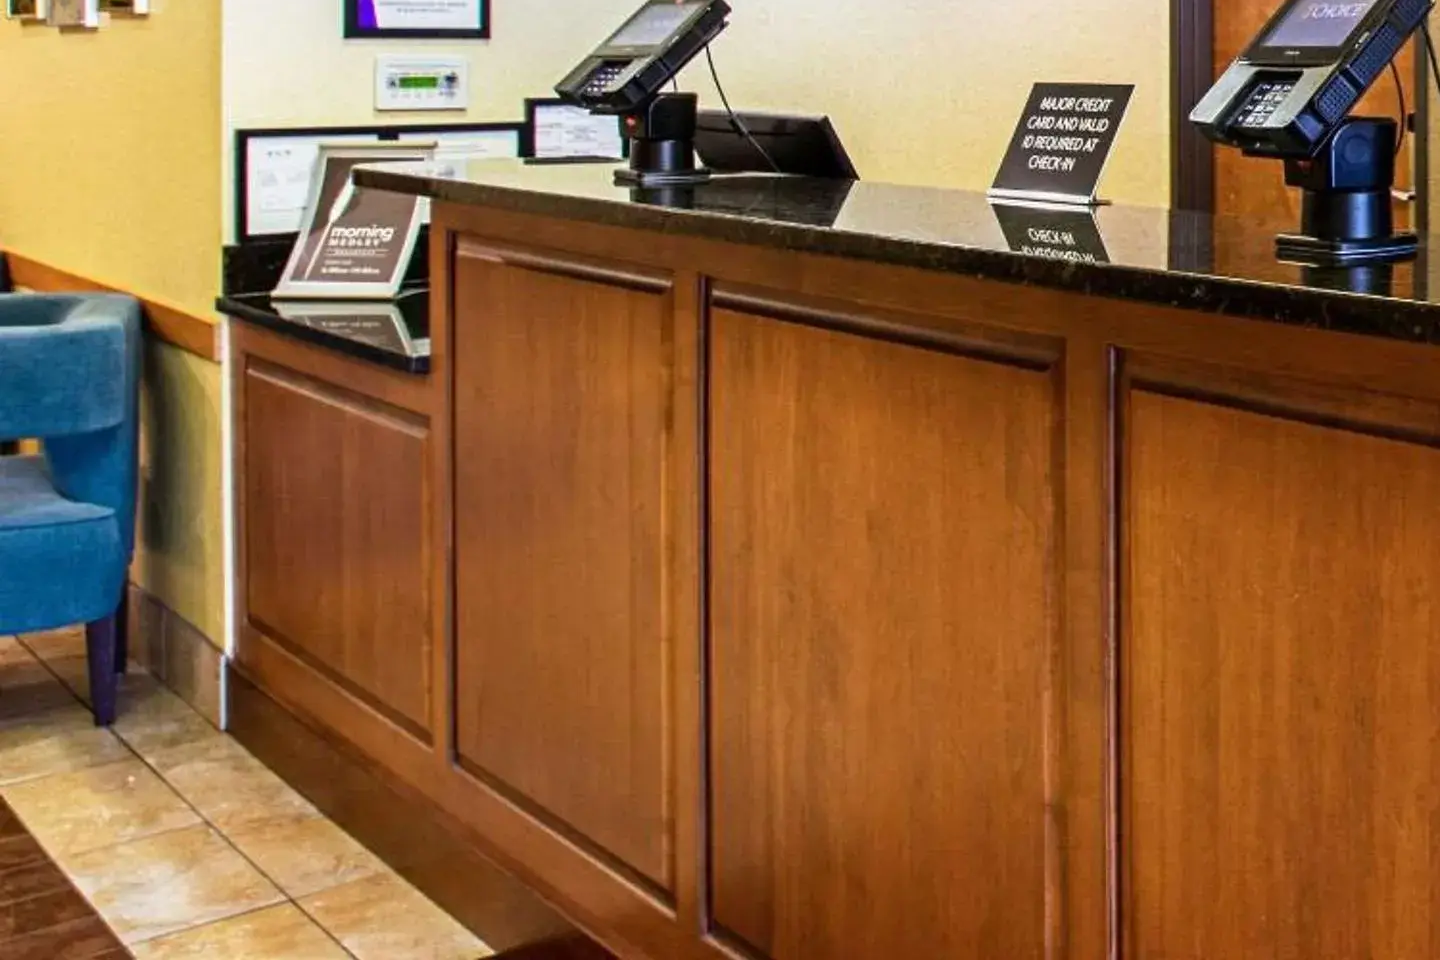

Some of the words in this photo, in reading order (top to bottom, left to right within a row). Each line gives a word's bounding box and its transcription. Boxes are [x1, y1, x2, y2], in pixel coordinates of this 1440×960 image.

[1039, 97, 1075, 112] MAJOR
[1074, 97, 1113, 112] CREDIT
[1026, 116, 1055, 131] CARD
[1055, 117, 1079, 131] AND
[1079, 118, 1109, 133] VALID
[1021, 135, 1035, 149] ID
[1034, 135, 1083, 152] REQUIRED
[1083, 138, 1100, 152] AT
[1028, 155, 1076, 172] CHECK-IN
[330, 223, 394, 243] morning
